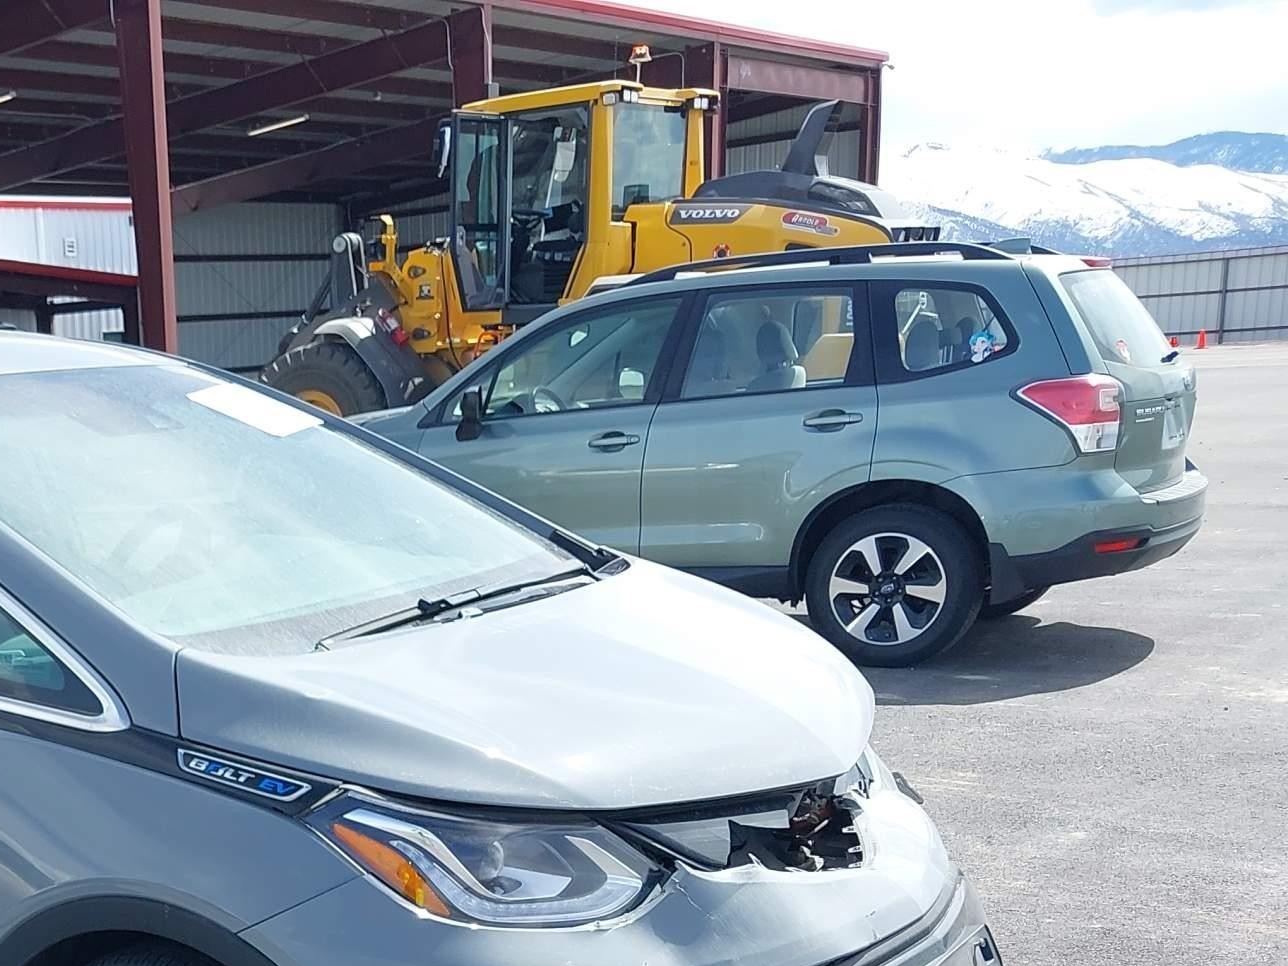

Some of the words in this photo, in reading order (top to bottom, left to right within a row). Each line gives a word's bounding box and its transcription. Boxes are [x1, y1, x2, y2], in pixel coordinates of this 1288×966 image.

[678, 208, 740, 219] VOLVO
[188, 758, 255, 783] BOLT
[260, 778, 296, 794] EV
